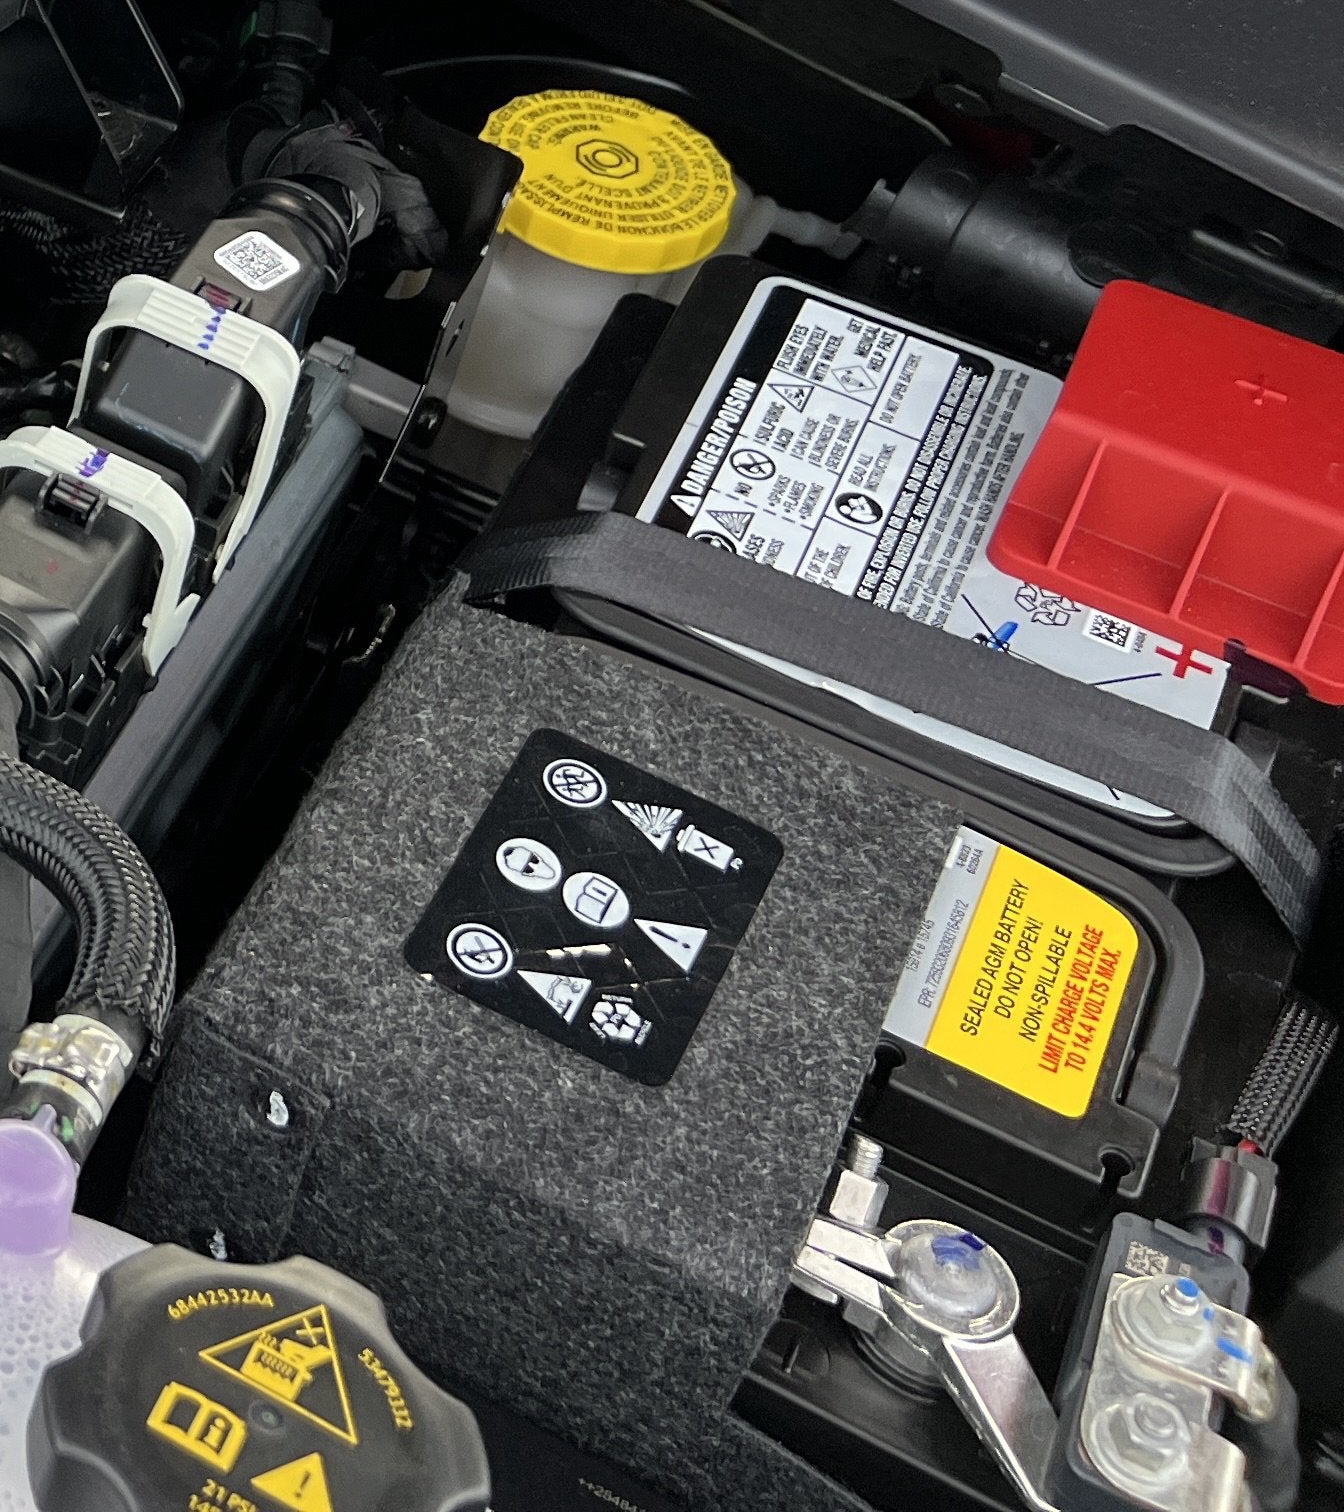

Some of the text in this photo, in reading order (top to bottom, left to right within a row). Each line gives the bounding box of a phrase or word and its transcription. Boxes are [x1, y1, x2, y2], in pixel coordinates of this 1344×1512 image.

[517, 180, 590, 226] REMPLISSAG
[595, 220, 612, 232] DE
[775, 323, 809, 370] FLUSH EYES
[865, 349, 888, 373] HELP
[679, 375, 758, 496] DANGER/POISON
[754, 400, 786, 442] SULFURIC
[772, 426, 794, 449] ACID
[790, 438, 809, 456] CAN
[733, 480, 753, 497] NO
[847, 465, 867, 486] READ
[958, 877, 1029, 1037] SEALED AGM BATTERY
[993, 914, 1043, 1019] DO NOT OPEN!
[1018, 923, 1073, 1043] NON-SPILLABLE
[1037, 922, 1103, 1074] LIMIT CHARGE VOLTAGE
[1063, 943, 1121, 1074] TO 14.4 VOLTS MAX.
[168, 1287, 274, 1322] 68442532AA
[202, 1479, 227, 1500] 21
